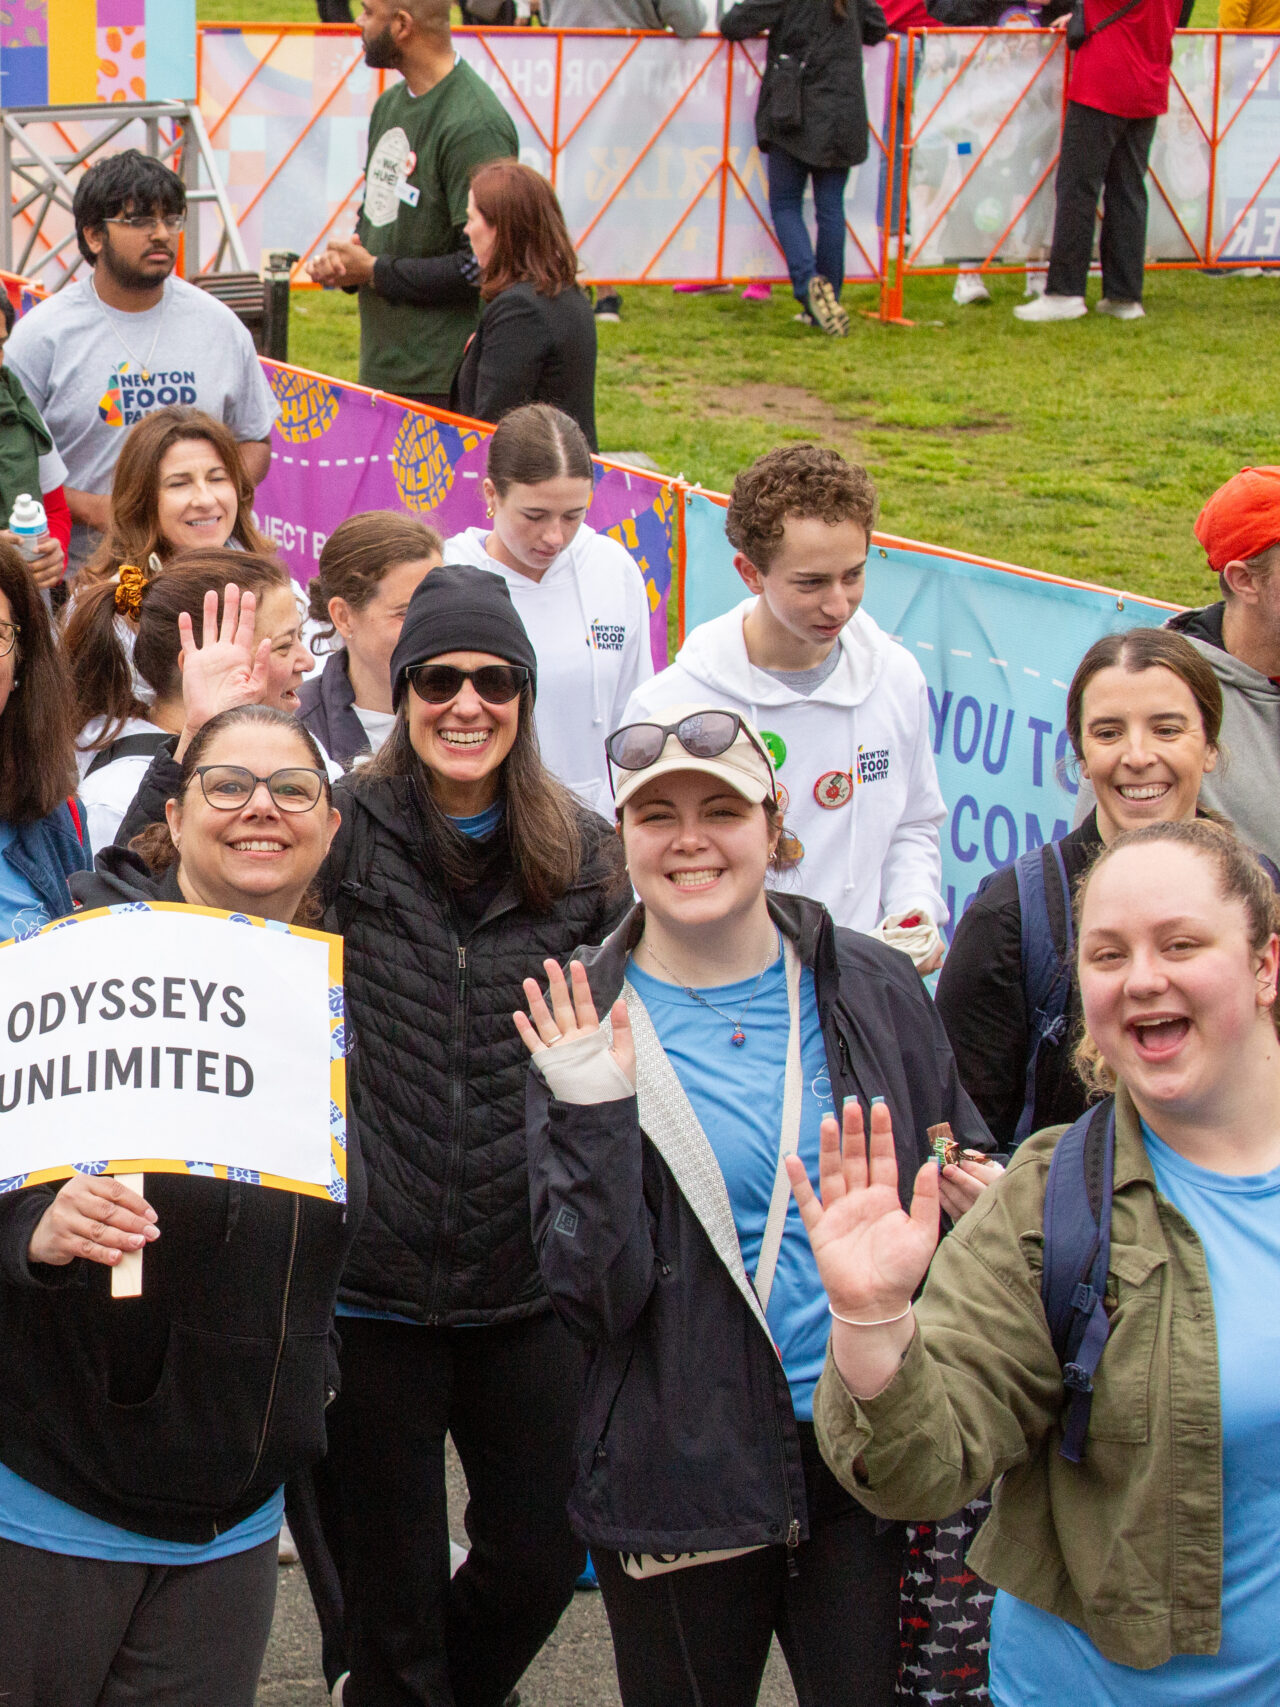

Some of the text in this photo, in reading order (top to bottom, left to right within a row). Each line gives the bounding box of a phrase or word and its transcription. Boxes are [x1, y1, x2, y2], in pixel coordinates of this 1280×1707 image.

[121, 371, 195, 387] NEWTON
[123, 387, 196, 408] FOOD
[125, 410, 151, 425] PA
[596, 633, 624, 642] FOOD
[927, 686, 1015, 775] YOU
[859, 749, 889, 761] NEWTON
[861, 758, 889, 773] FOOD
[863, 770, 888, 783] PANTRY
[7, 976, 247, 1043] ODYSSEYS
